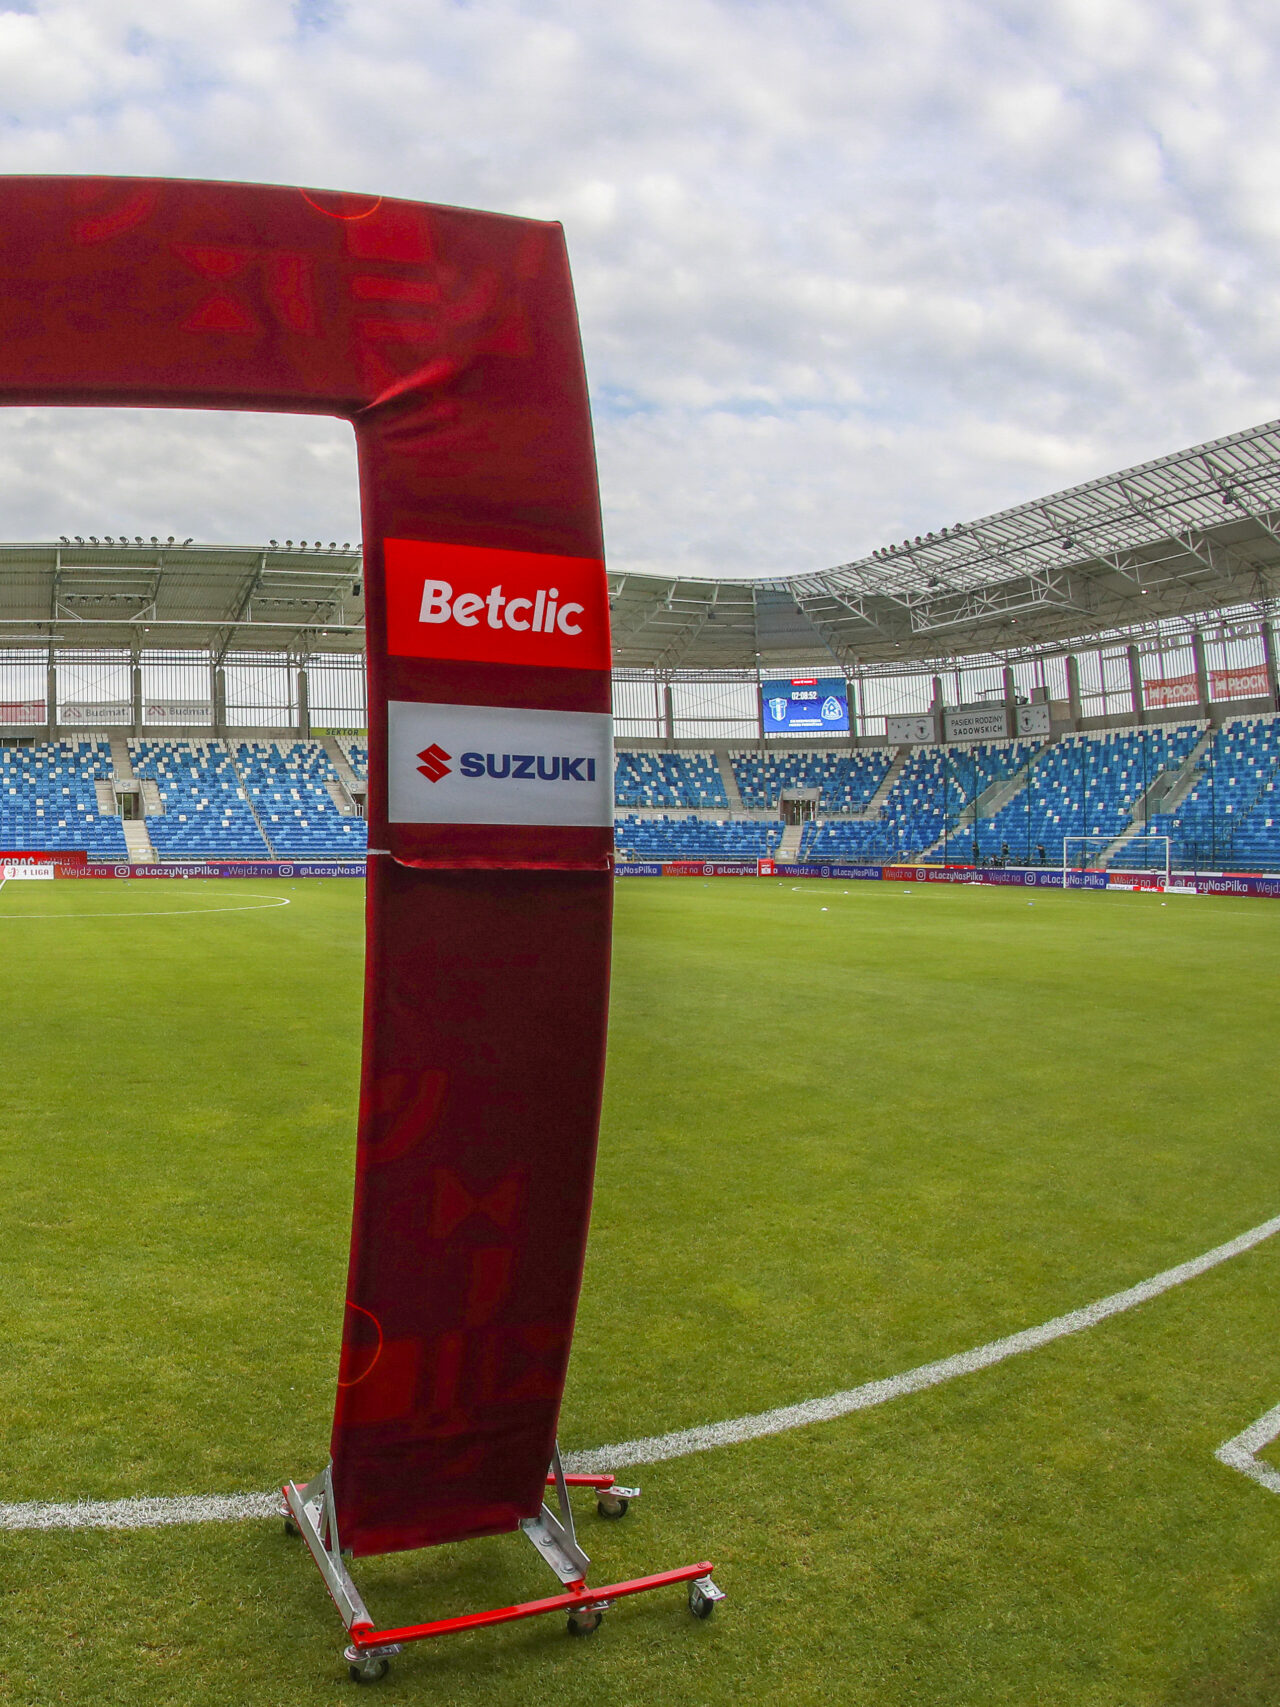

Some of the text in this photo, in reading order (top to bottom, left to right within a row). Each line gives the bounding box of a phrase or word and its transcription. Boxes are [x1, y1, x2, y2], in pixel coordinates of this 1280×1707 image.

[417, 578, 585, 637] Betclic
[951, 715, 1003, 727] PASIEKI RODZINY
[953, 725, 1003, 736] SADOWSKICH
[458, 752, 596, 782] SUZUKI
[61, 867, 92, 877] Wejdź
[135, 866, 220, 877] @LaczyNasPilka
[1256, 881, 1280, 896] Wejd
